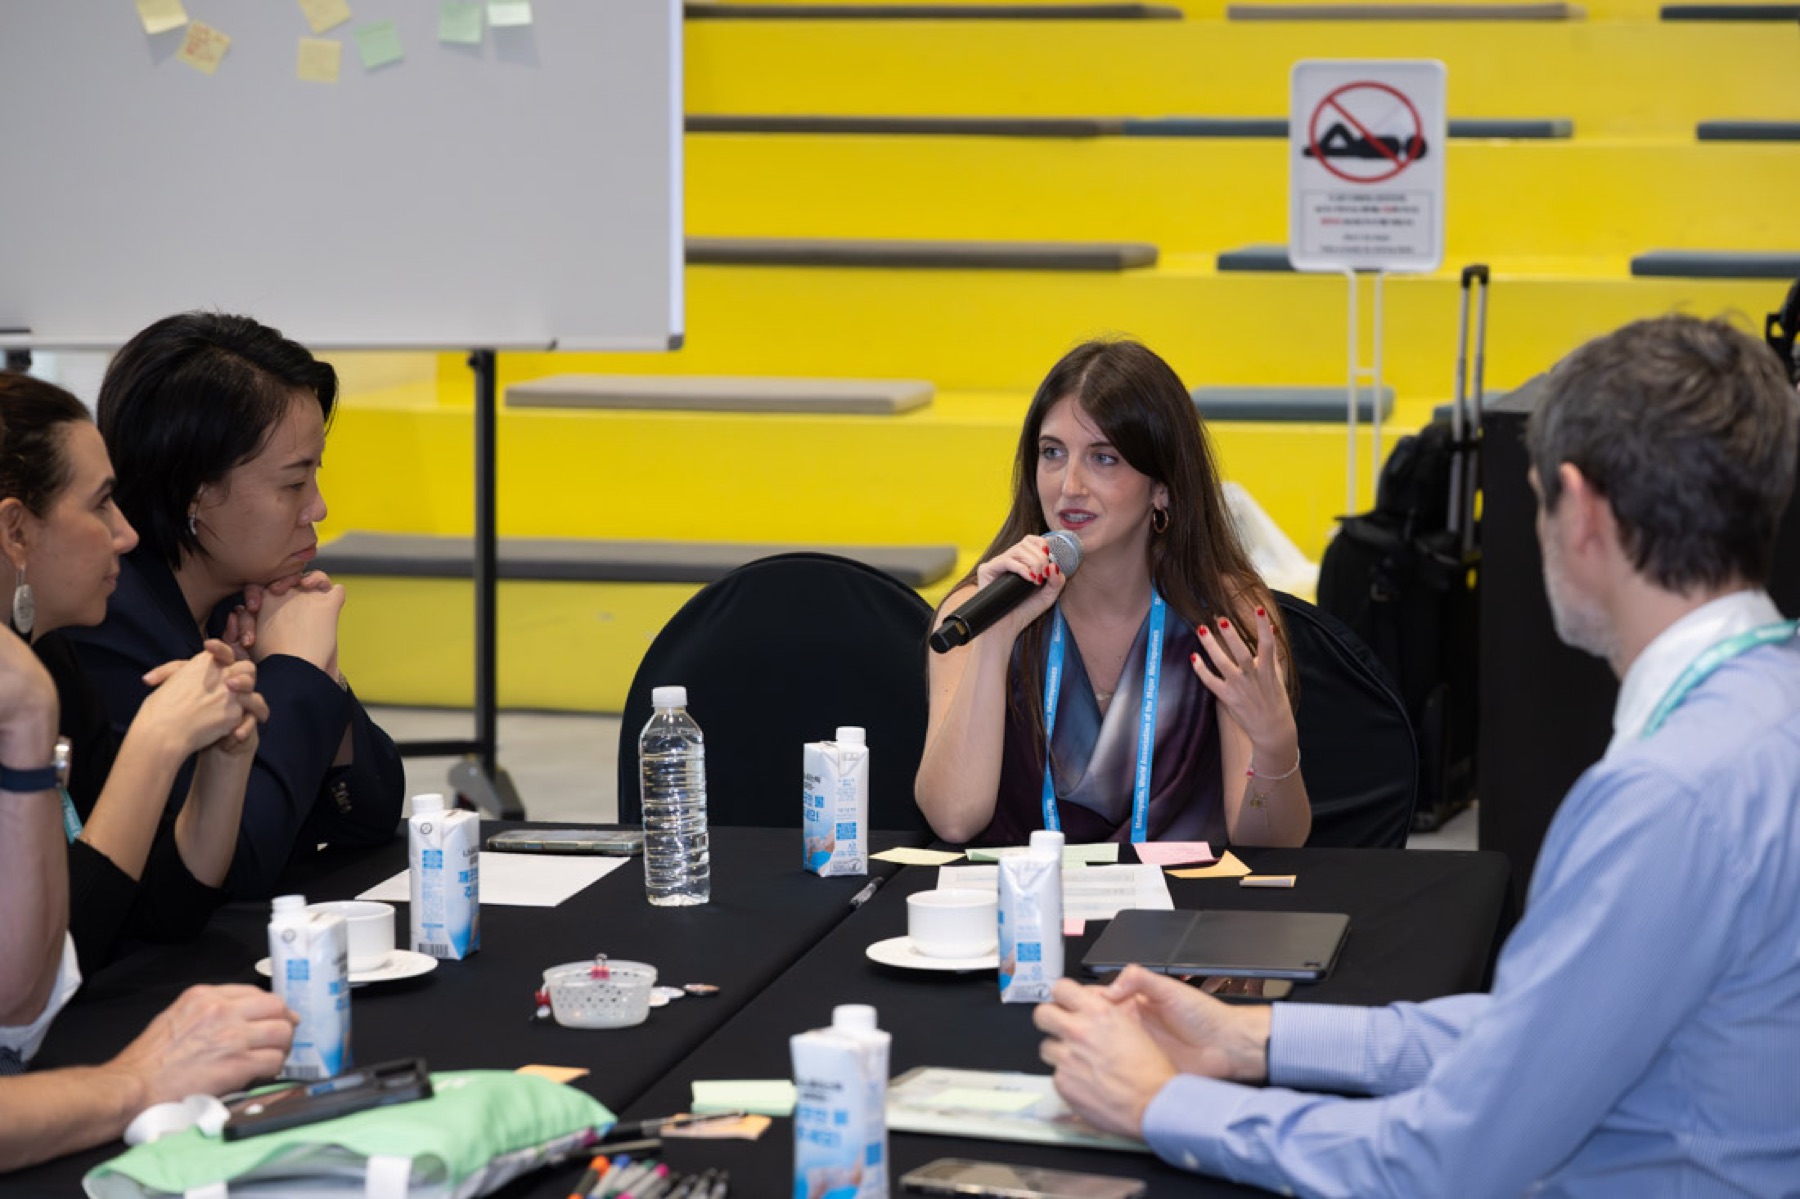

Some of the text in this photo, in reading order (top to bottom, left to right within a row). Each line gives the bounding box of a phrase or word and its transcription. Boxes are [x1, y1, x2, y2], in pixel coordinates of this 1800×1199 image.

[1145, 701, 1153, 712] the
[1144, 713, 1151, 721] of
[1139, 722, 1150, 764] Association
[1138, 766, 1148, 788] World
